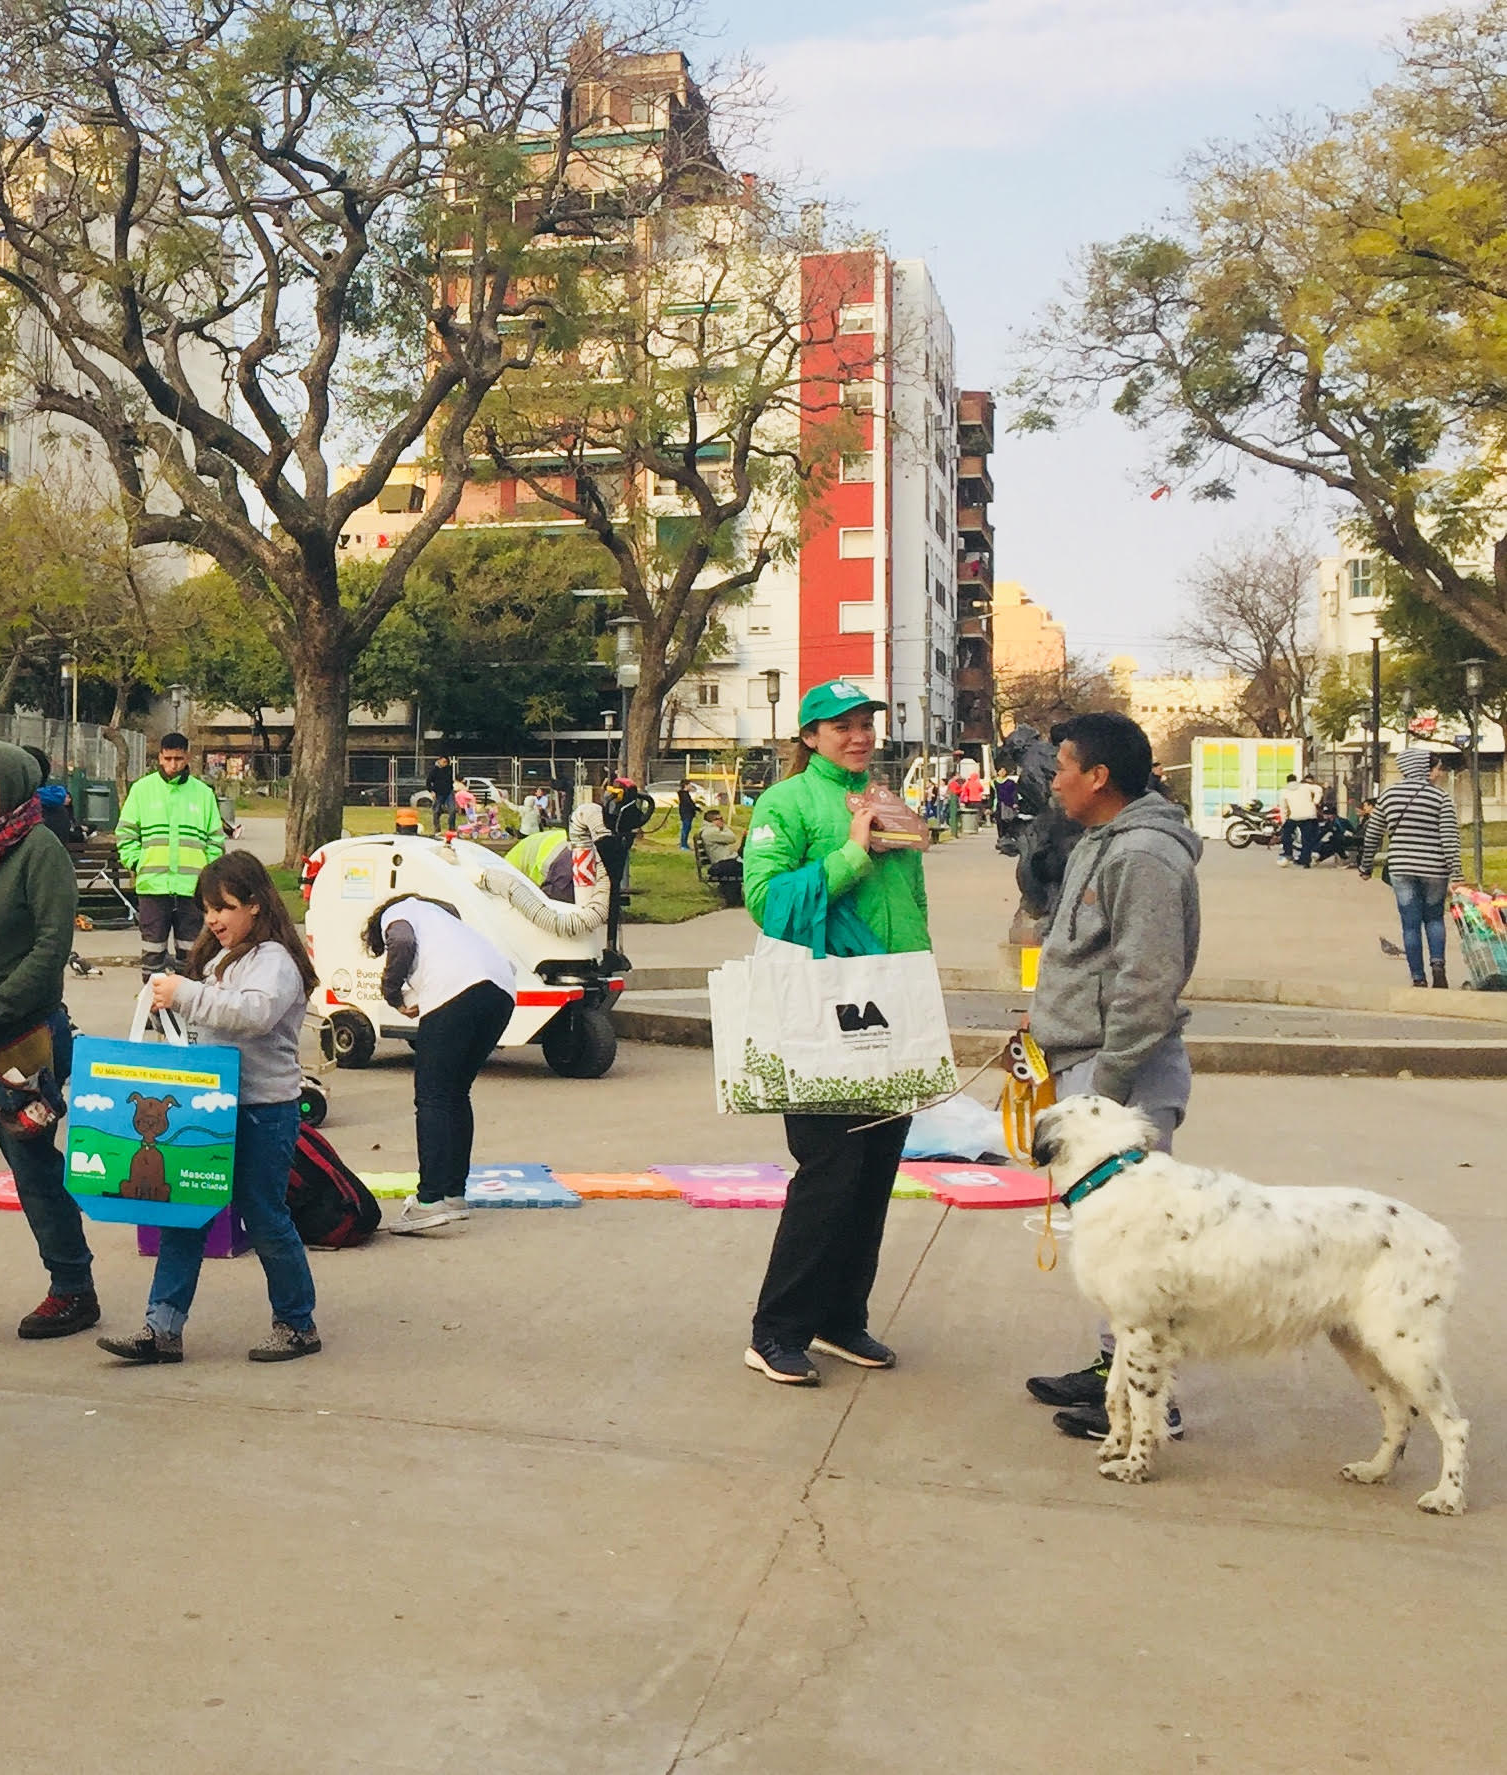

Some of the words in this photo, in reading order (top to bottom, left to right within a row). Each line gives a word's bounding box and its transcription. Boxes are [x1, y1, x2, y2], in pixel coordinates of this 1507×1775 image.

[836, 1001, 889, 1031] BA
[71, 1151, 106, 1175] BA
[180, 1168, 226, 1181] Mascotas
[200, 1181, 229, 1191] Ciudad
